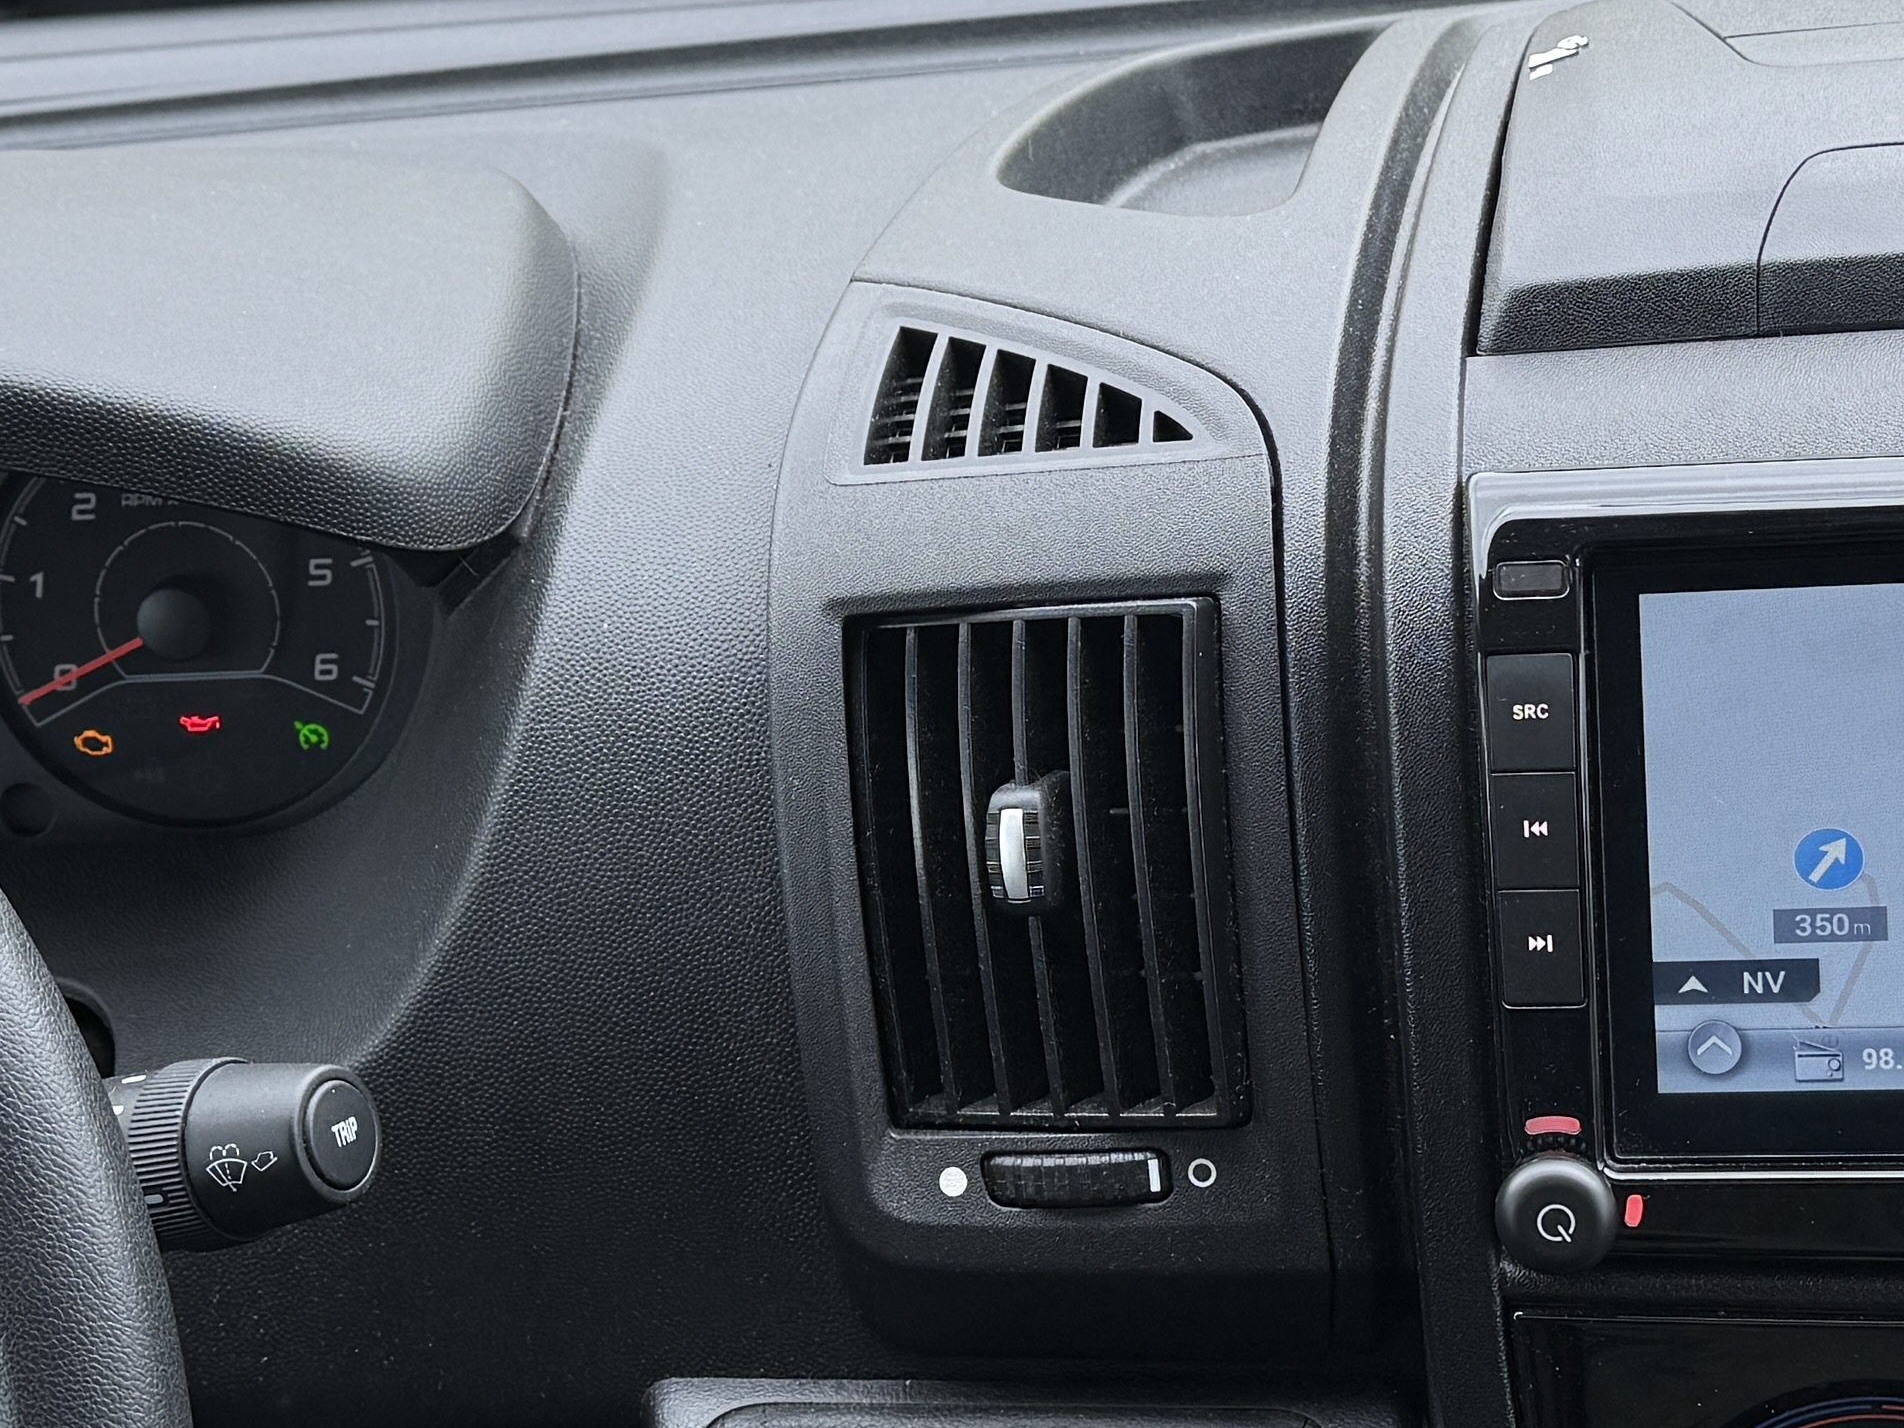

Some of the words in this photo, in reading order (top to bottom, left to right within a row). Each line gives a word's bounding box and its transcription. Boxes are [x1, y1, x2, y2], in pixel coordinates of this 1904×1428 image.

[70, 492, 97, 521] 2
[29, 571, 44, 599] 1
[307, 558, 333, 587] 5
[313, 652, 339, 681] 6
[1512, 703, 1549, 720] SRC
[1743, 970, 1786, 995] NV
[330, 1116, 358, 1148] TRIP
